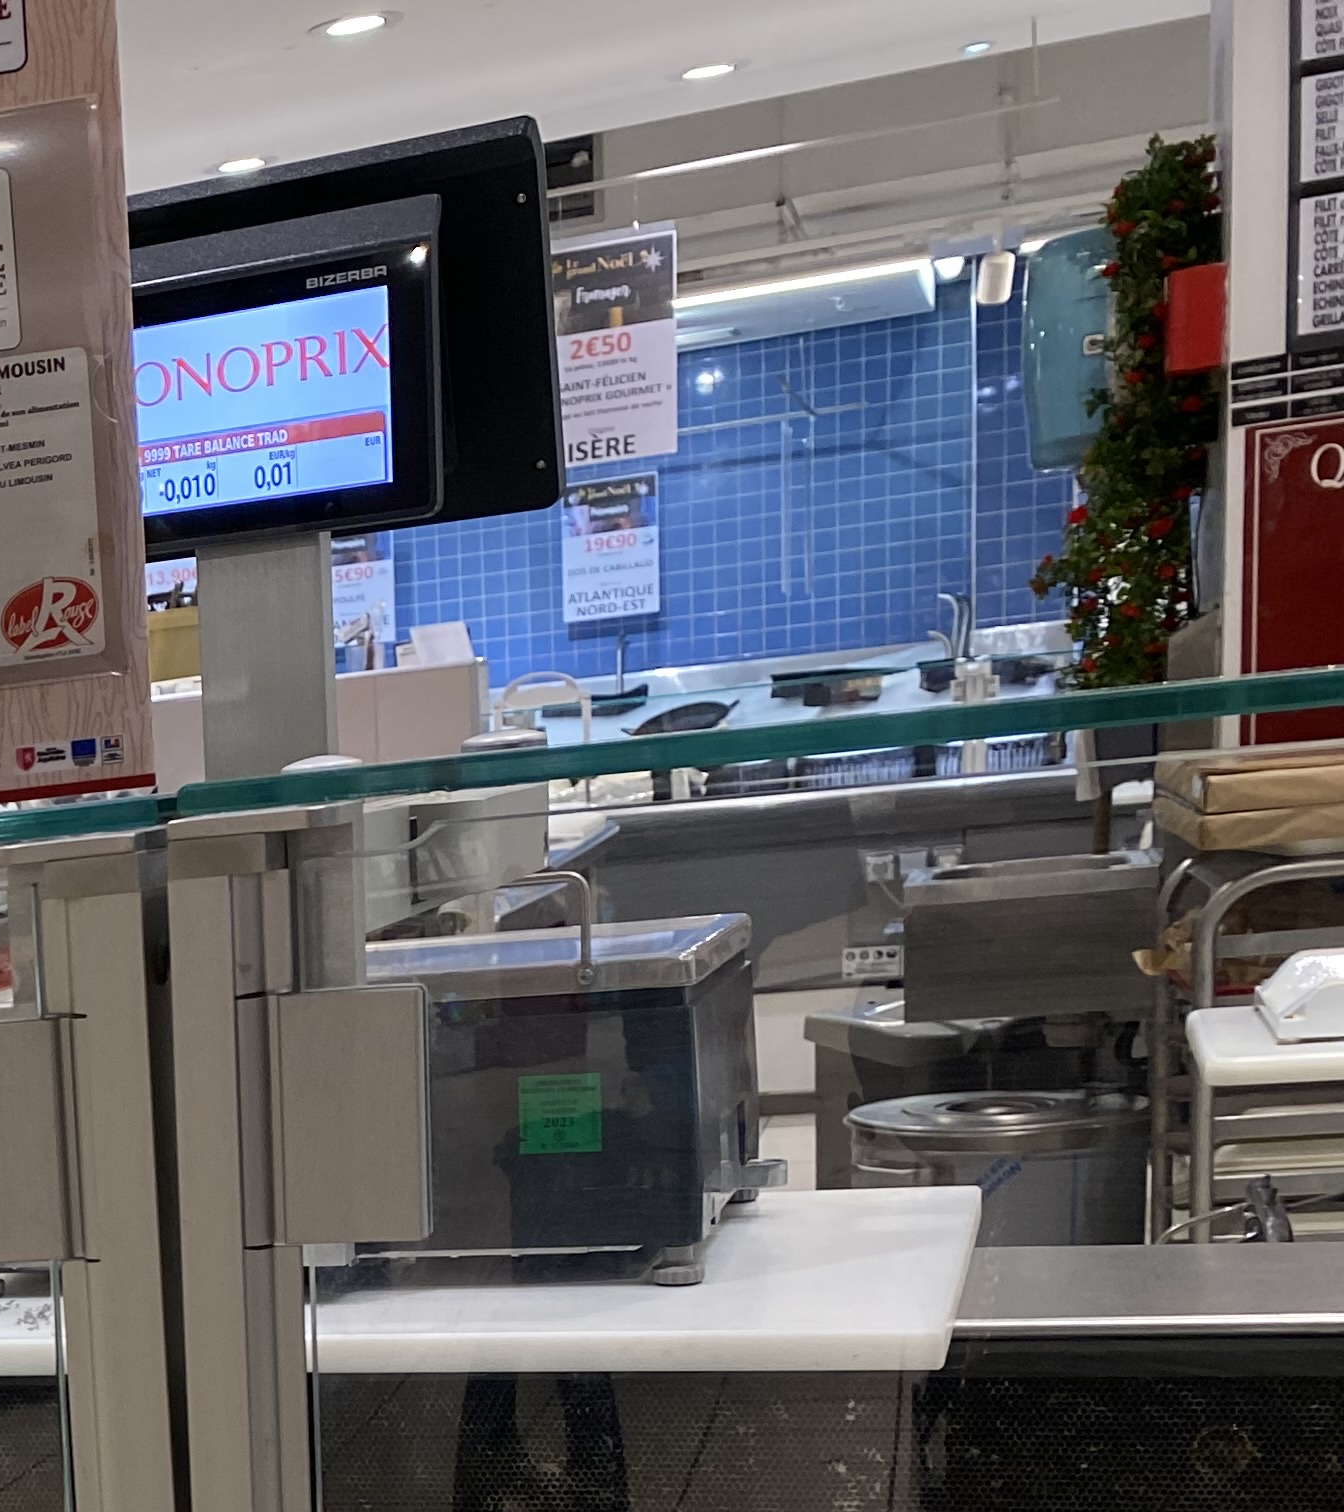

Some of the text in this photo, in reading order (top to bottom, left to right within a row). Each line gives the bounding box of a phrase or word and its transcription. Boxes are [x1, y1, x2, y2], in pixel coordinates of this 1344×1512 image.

[306, 265, 387, 289] BIZERBA
[569, 332, 631, 360] 2€50
[561, 371, 646, 392] AINT-FÉLICIEN
[605, 383, 661, 400] GOURMET
[143, 429, 289, 462] 9999 TARE BALANCE TRAD
[146, 467, 161, 478] NET
[206, 460, 216, 470] kg
[364, 436, 381, 447] EUR
[568, 434, 636, 462] ISÈRE
[254, 461, 293, 491] 0,01
[1311, 443, 1344, 489] Q
[585, 533, 637, 553] 19€90
[568, 583, 655, 605] ATLANTIQUE
[576, 598, 646, 617] NORD-EST
[7, 606, 40, 639] label
[543, 1117, 575, 1128] 2023
